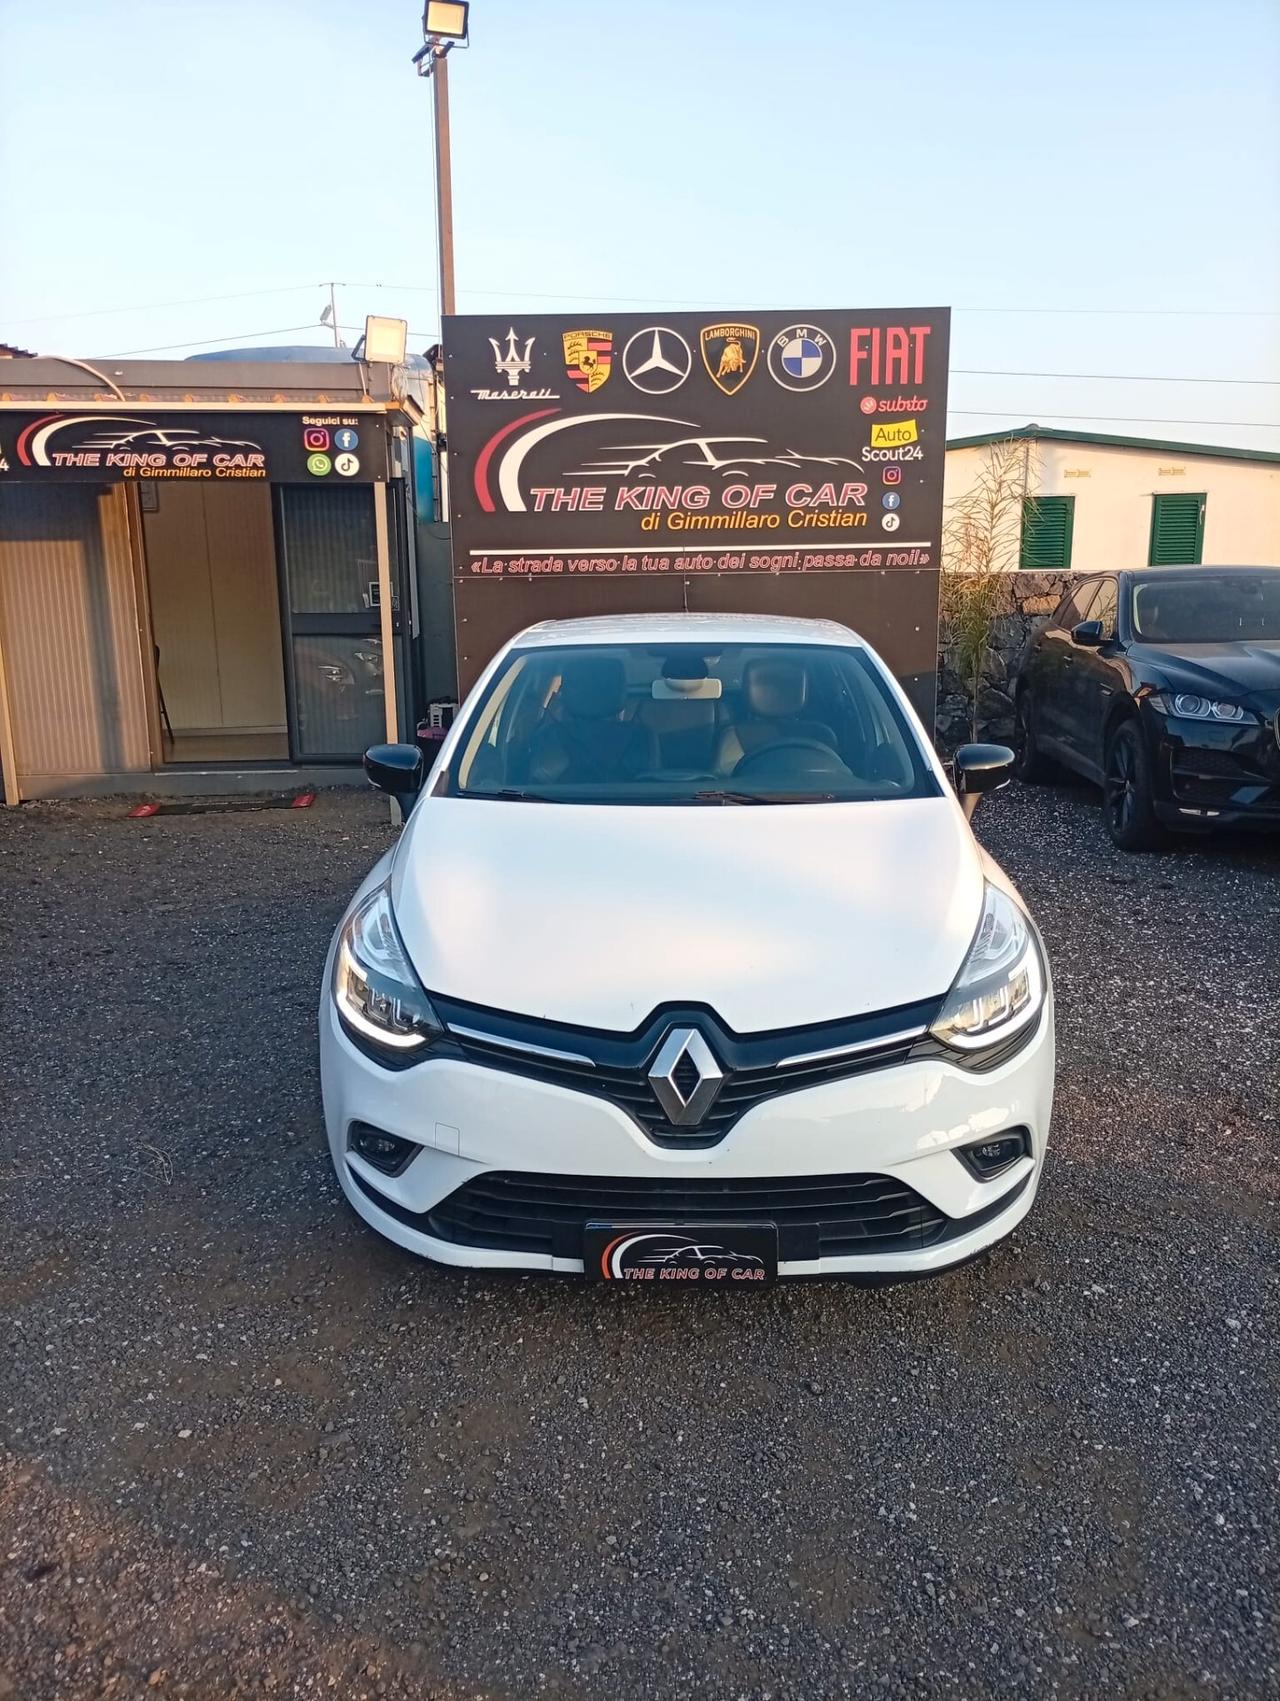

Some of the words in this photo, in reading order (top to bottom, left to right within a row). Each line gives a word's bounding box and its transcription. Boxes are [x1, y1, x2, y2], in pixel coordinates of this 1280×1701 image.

[704, 327, 756, 341] LAMBORGHINI
[777, 328, 826, 348] BMW
[849, 326, 931, 386] FIAT
[877, 395, 929, 412] subito
[874, 427, 912, 442] Auto
[52, 453, 101, 466] THE
[106, 453, 166, 467] KING
[172, 453, 208, 467] OF
[212, 453, 265, 467] CAR
[861, 446, 924, 462] Scout24
[123, 467, 135, 477] di
[140, 467, 212, 478] Gimmillaro
[215, 467, 266, 478] Cristian
[530, 487, 607, 512] THE
[614, 485, 711, 511] KING
[721, 484, 777, 509] OF
[785, 482, 868, 508] CAR
[641, 513, 660, 531] di
[667, 511, 780, 531] Gimmillaro
[787, 509, 868, 528] Cristian
[508, 556, 563, 573] strada
[567, 559, 617, 572] verso
[621, 555, 637, 571] la
[641, 556, 670, 571] tua
[674, 555, 713, 570] auto
[717, 552, 746, 570] dei
[802, 553, 856, 571] passa
[859, 551, 881, 567] da
[624, 1268, 655, 1280] THE
[659, 1268, 700, 1280] KING
[704, 1268, 728, 1280] OF
[731, 1268, 765, 1280] CAR
